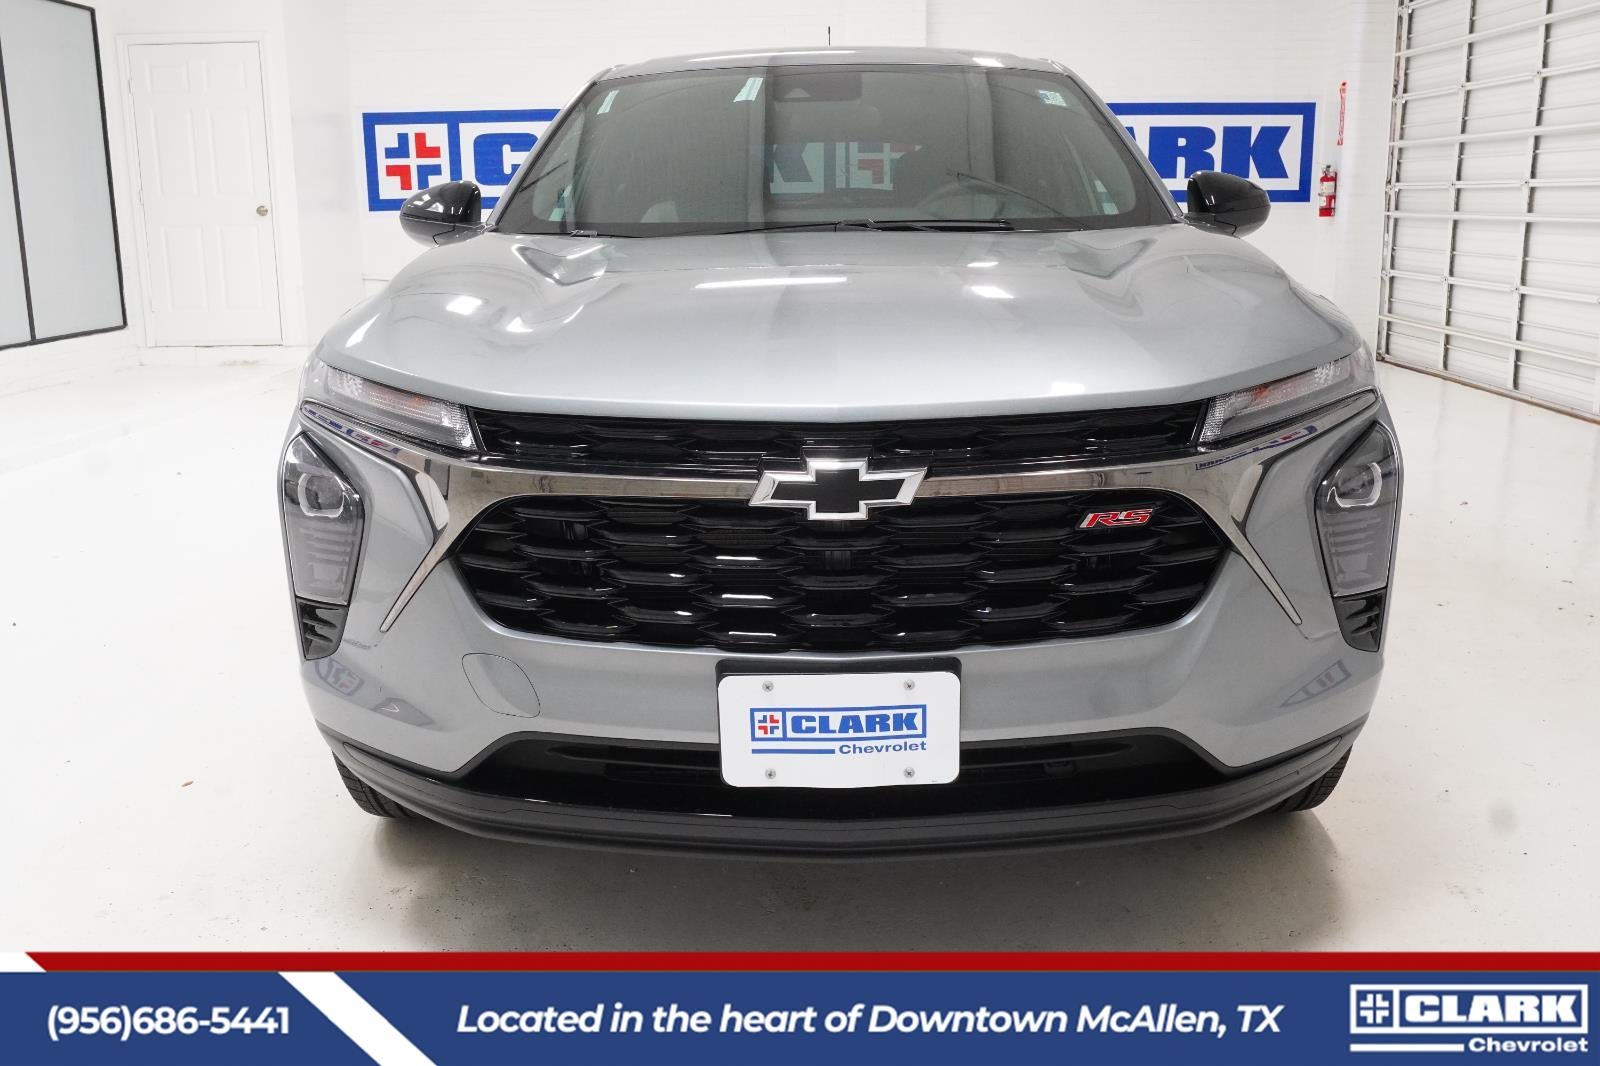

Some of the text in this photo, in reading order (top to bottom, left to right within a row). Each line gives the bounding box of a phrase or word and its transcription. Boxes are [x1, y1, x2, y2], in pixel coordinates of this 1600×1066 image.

[1079, 508, 1153, 528] RS
[790, 712, 918, 735] CLARK
[838, 740, 927, 755] Chevrolet
